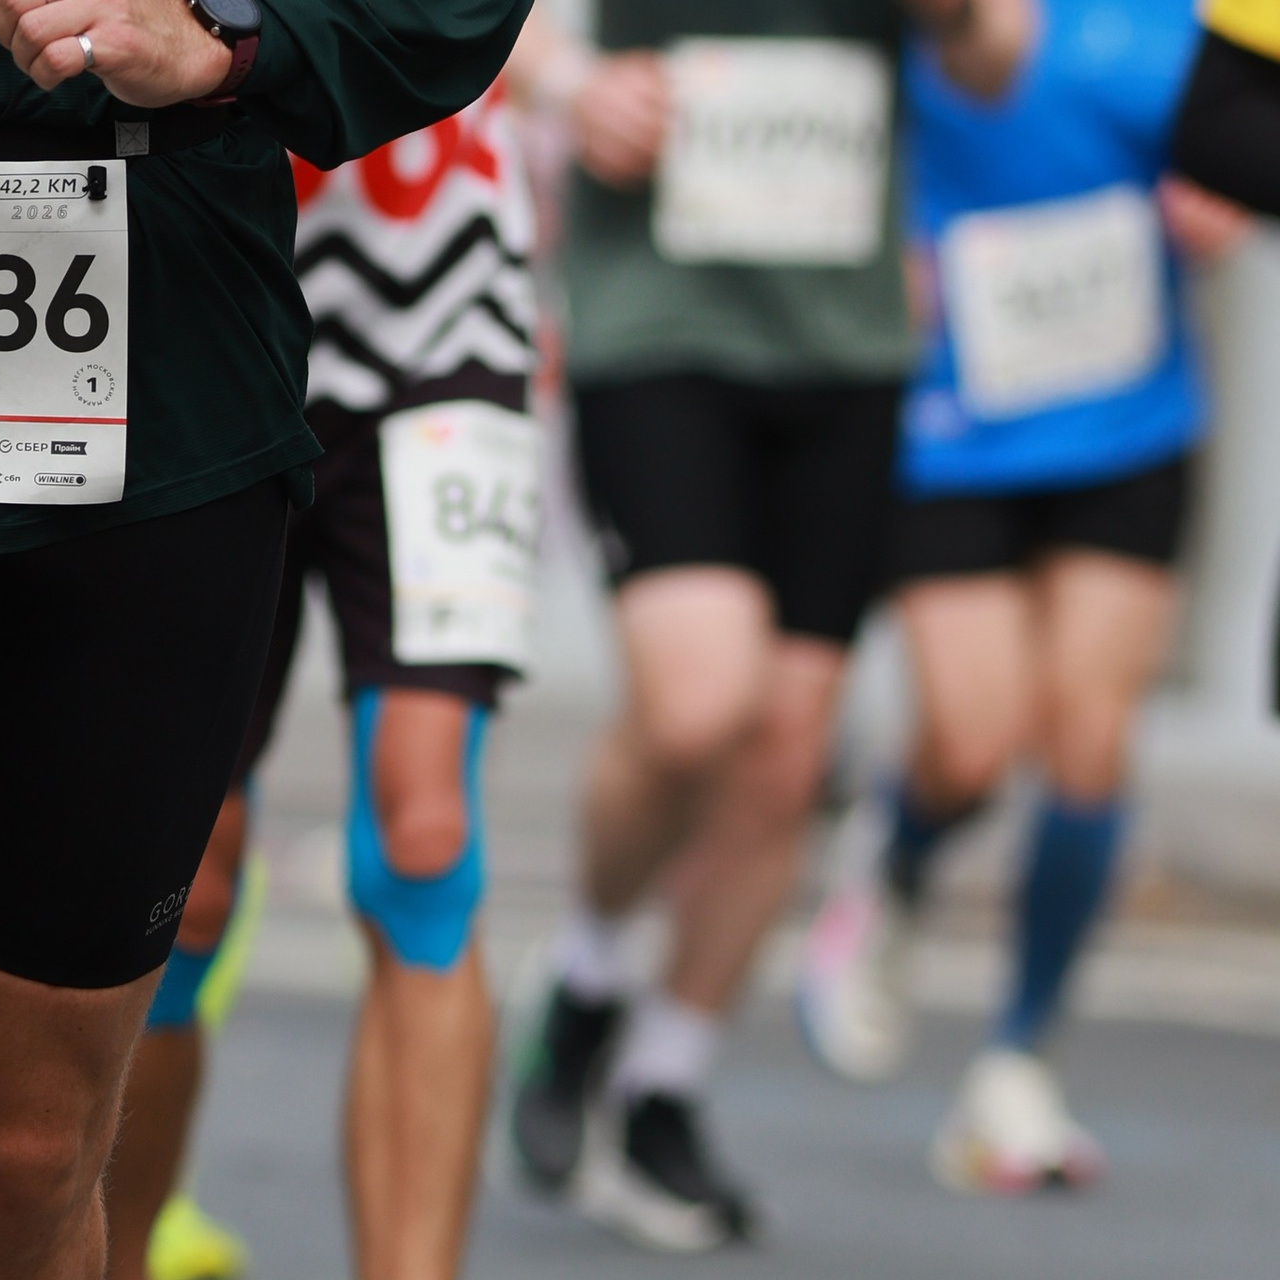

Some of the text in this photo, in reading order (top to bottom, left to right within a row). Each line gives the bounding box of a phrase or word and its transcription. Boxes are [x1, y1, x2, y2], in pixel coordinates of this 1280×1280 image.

[0, 177, 77, 196] 42,2 КМ
[11, 204, 69, 220] 2026
[86, 377, 97, 393] 1
[15, 442, 82, 453] СБЕР Прайм
[38, 476, 75, 484] WINLINE
